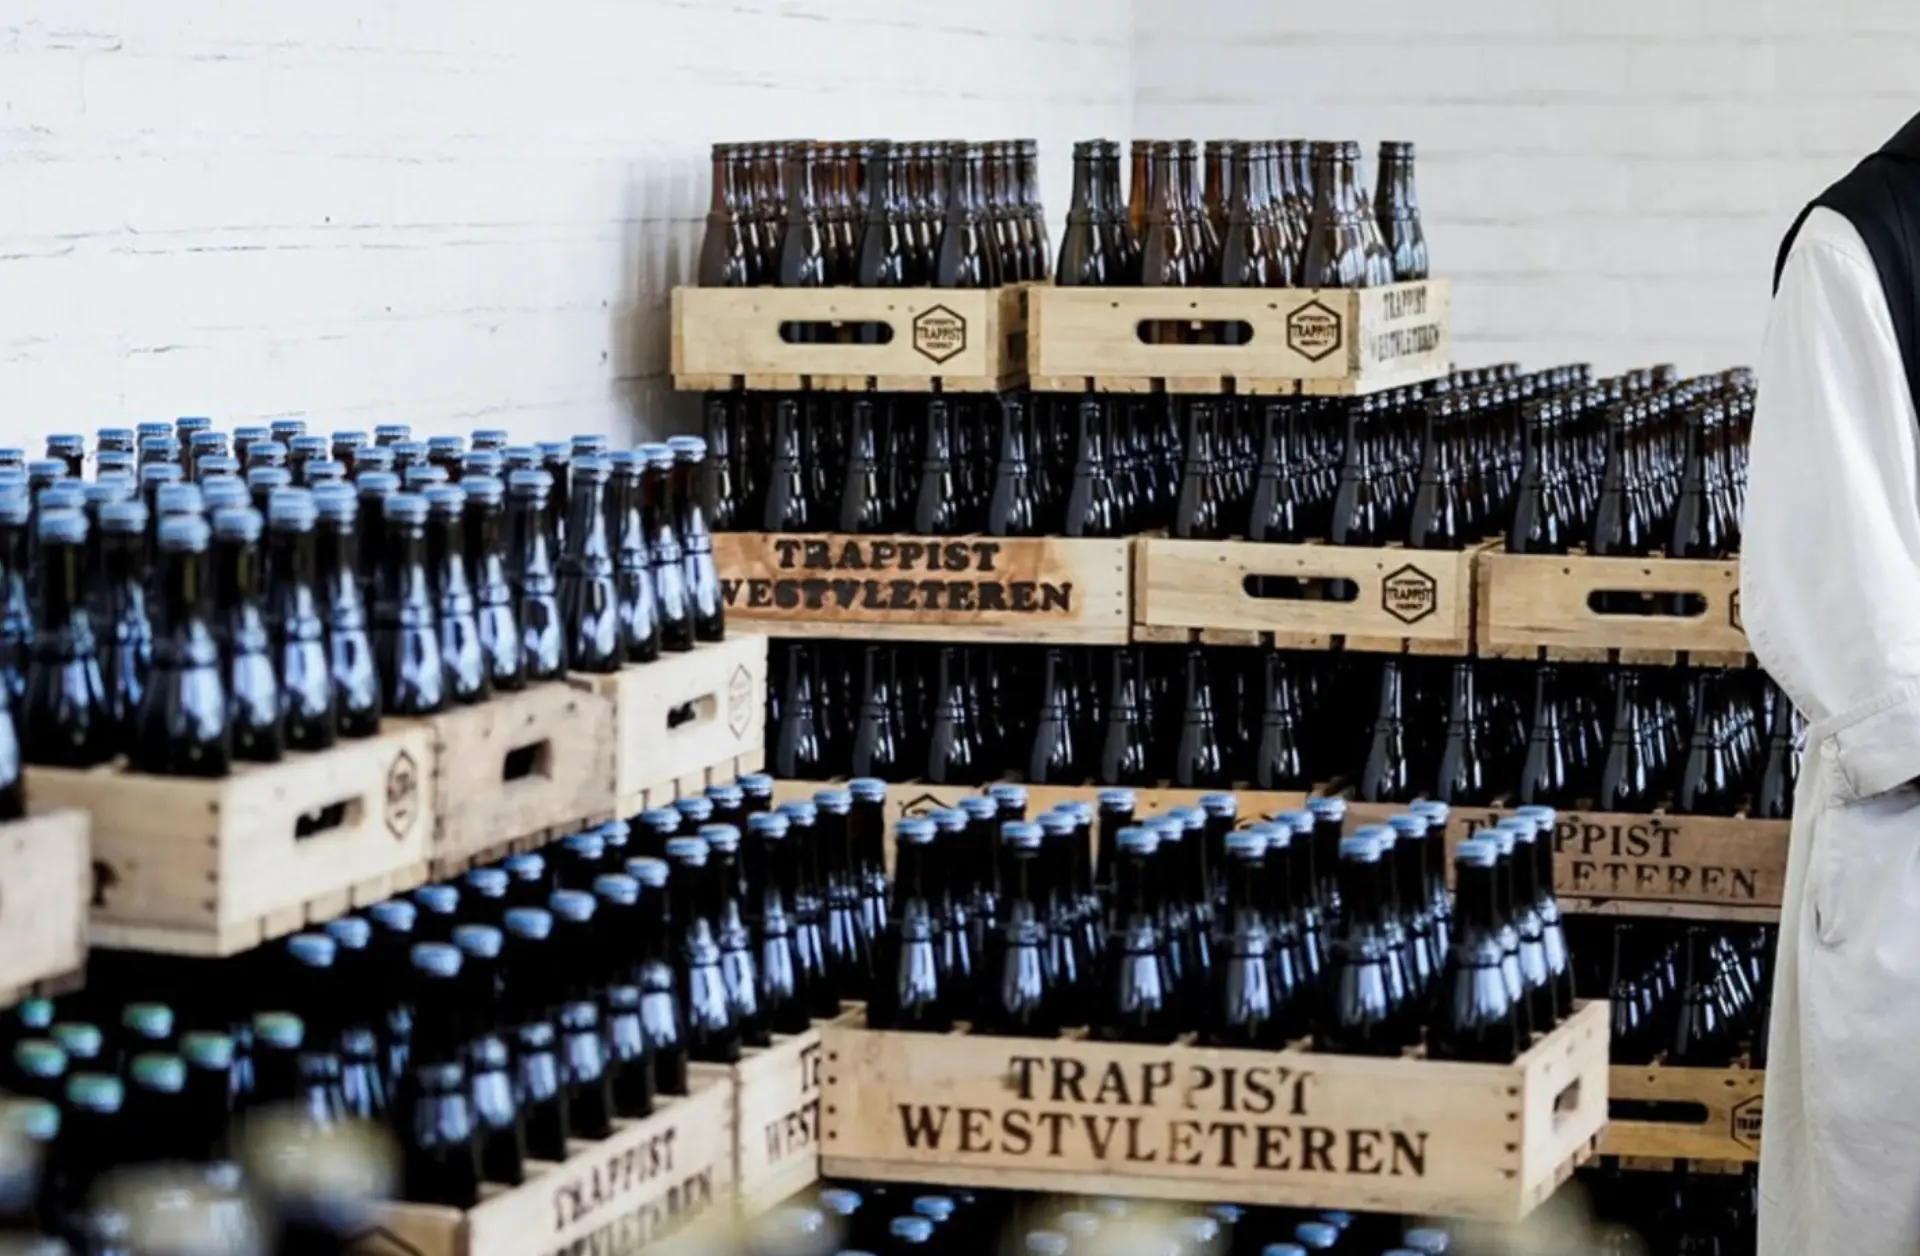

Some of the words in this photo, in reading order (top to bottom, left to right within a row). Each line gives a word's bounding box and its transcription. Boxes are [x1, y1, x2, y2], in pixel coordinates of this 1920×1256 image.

[775, 540, 1001, 570] TRAPPIST
[1460, 812, 1680, 858] TPPIST
[1009, 1055, 1318, 1116] TRAPPIST
[899, 1103, 1429, 1177] WESTVLETEREN
